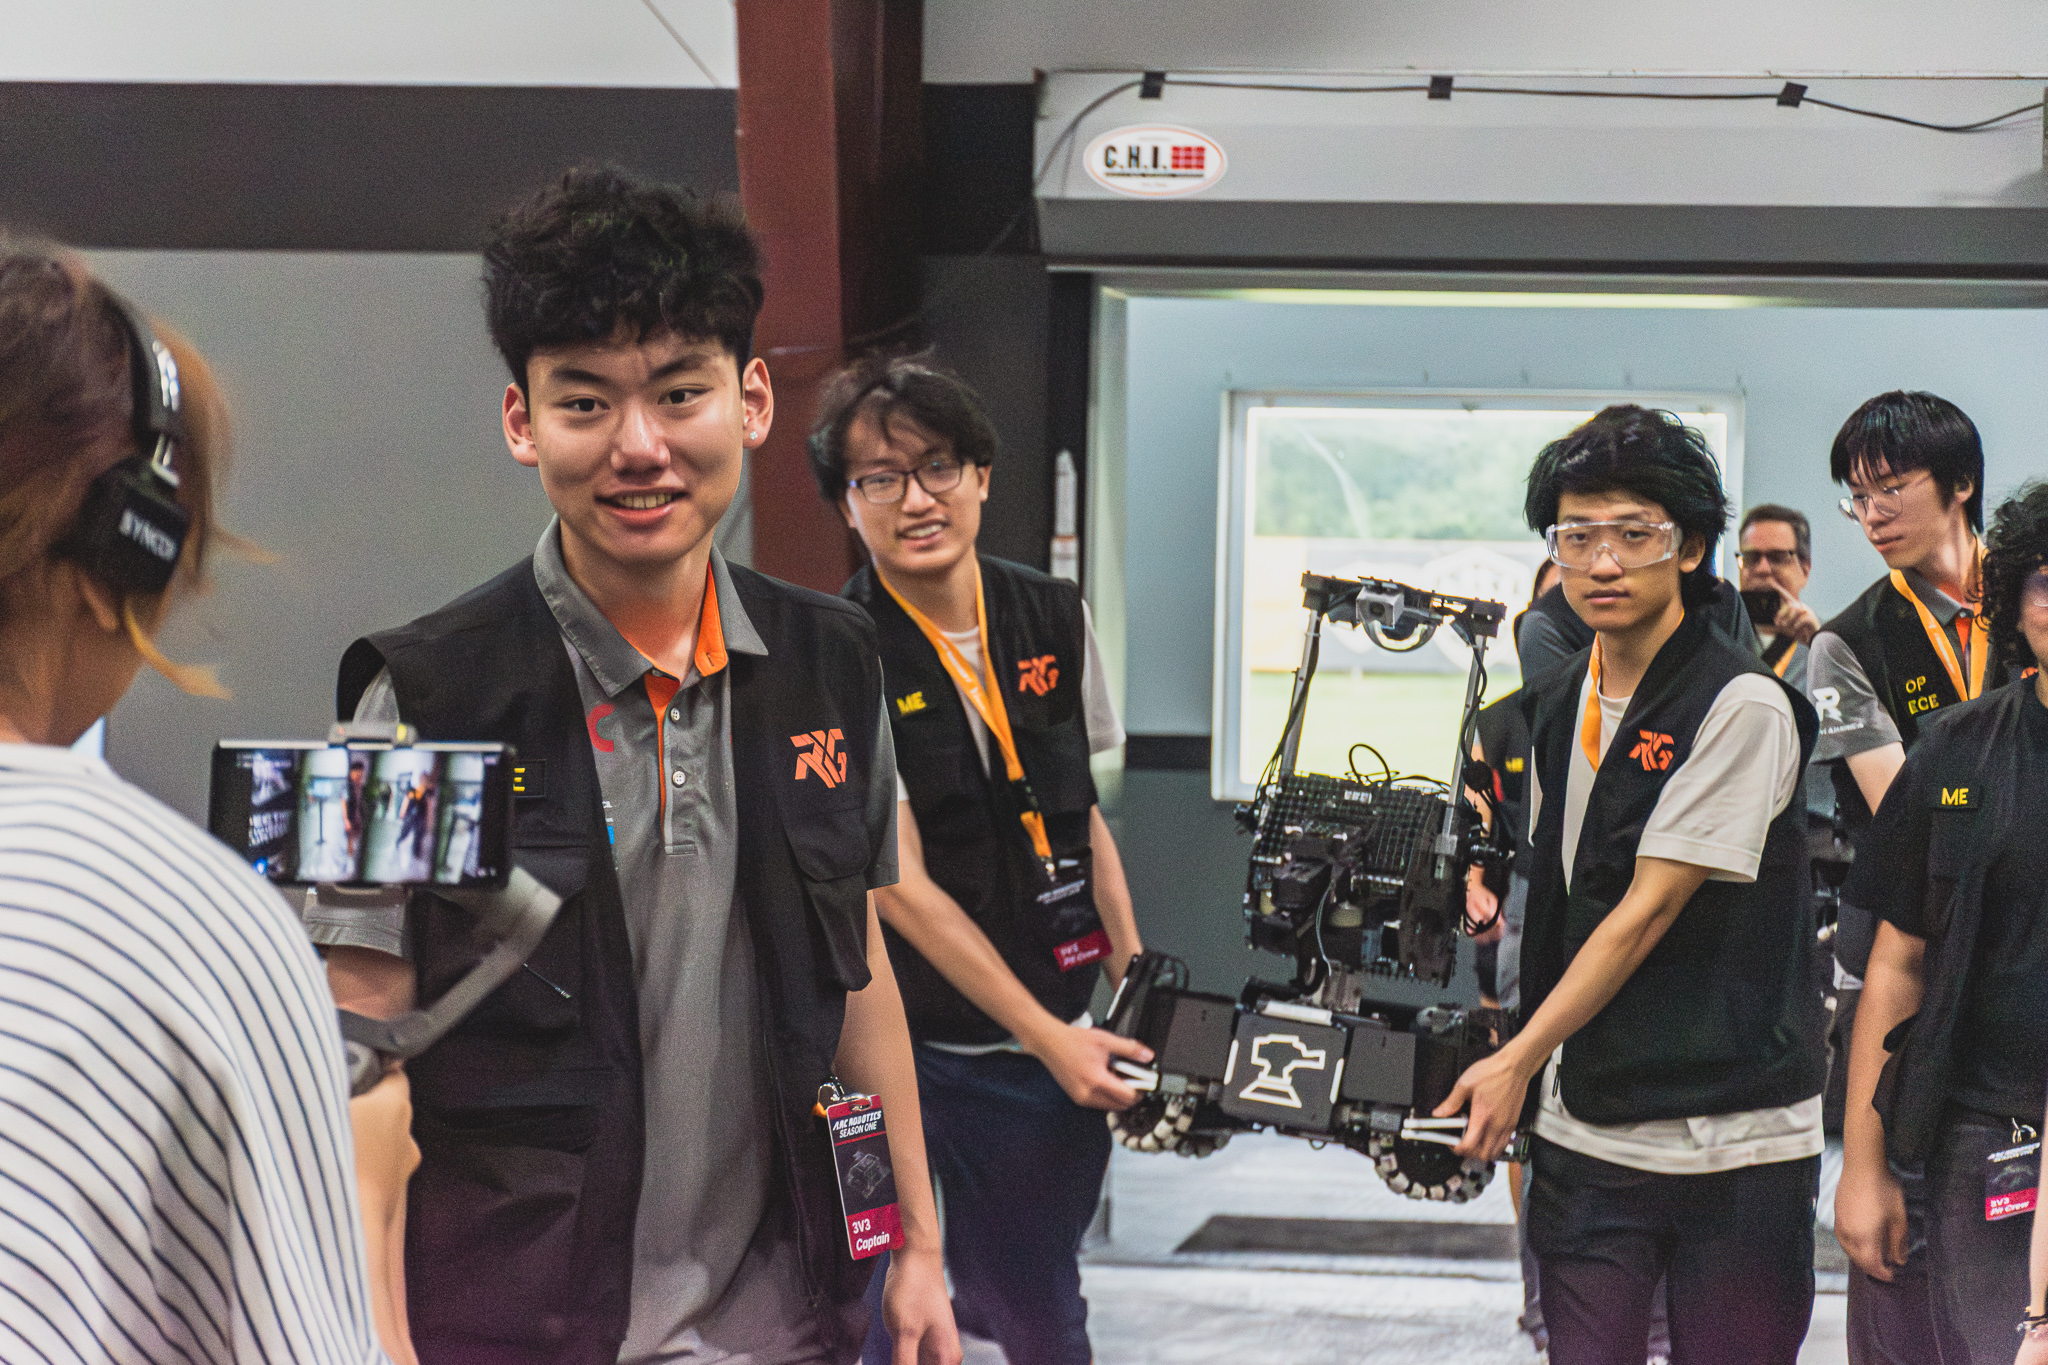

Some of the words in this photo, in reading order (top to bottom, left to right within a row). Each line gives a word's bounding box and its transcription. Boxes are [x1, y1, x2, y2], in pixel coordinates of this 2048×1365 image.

[1905, 675, 1926, 694] OP
[896, 691, 927, 717] ME
[1908, 693, 1940, 715] ECE
[1941, 787, 1970, 806] ME
[839, 1124, 864, 1139] SEASON
[864, 1120, 878, 1132] ONE
[852, 1218, 872, 1235] 3V3
[856, 1231, 890, 1252] Captain
